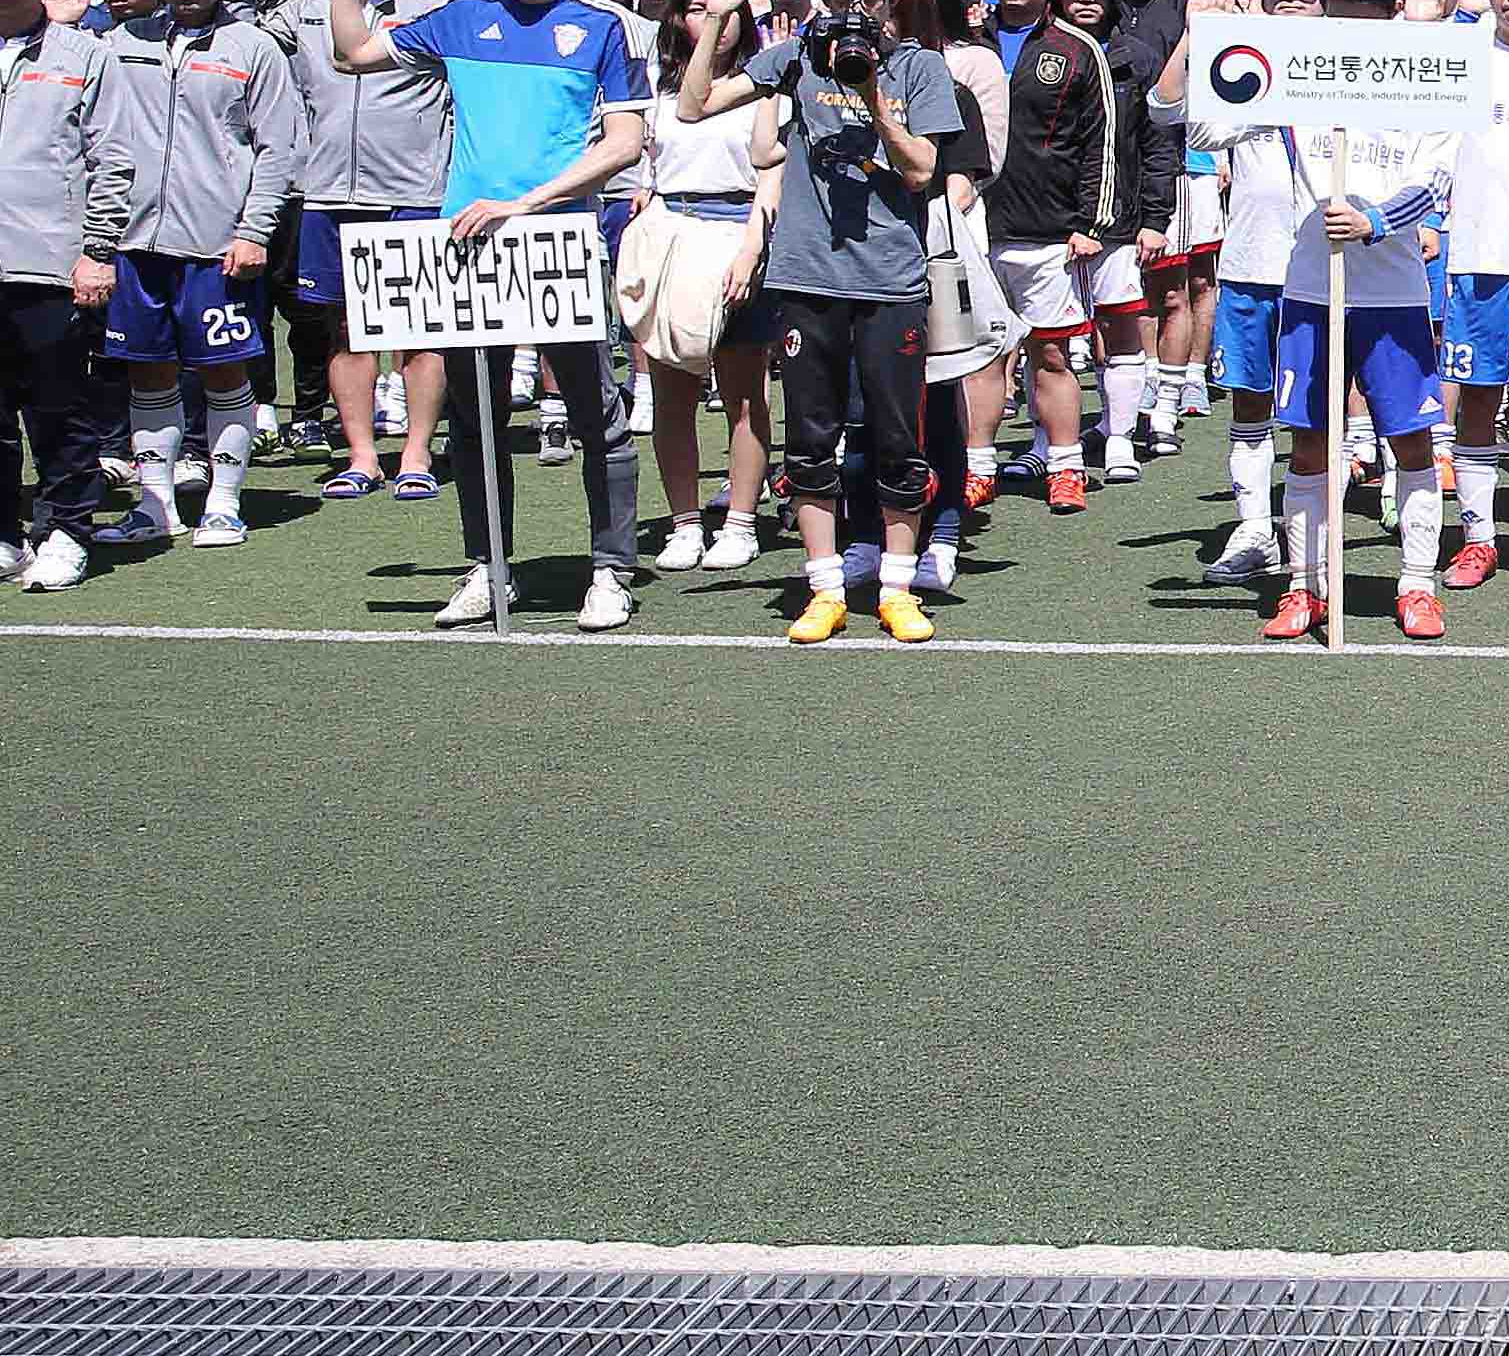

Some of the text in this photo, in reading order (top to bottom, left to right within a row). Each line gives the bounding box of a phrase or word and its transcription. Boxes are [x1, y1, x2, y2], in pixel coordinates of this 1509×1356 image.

[1286, 55, 1468, 83] 산업통상자원부
[1286, 90, 1323, 101] Ministry
[1413, 92, 1431, 101] and
[350, 227, 594, 336] 한국산업단지공단
[203, 302, 253, 347] 25
